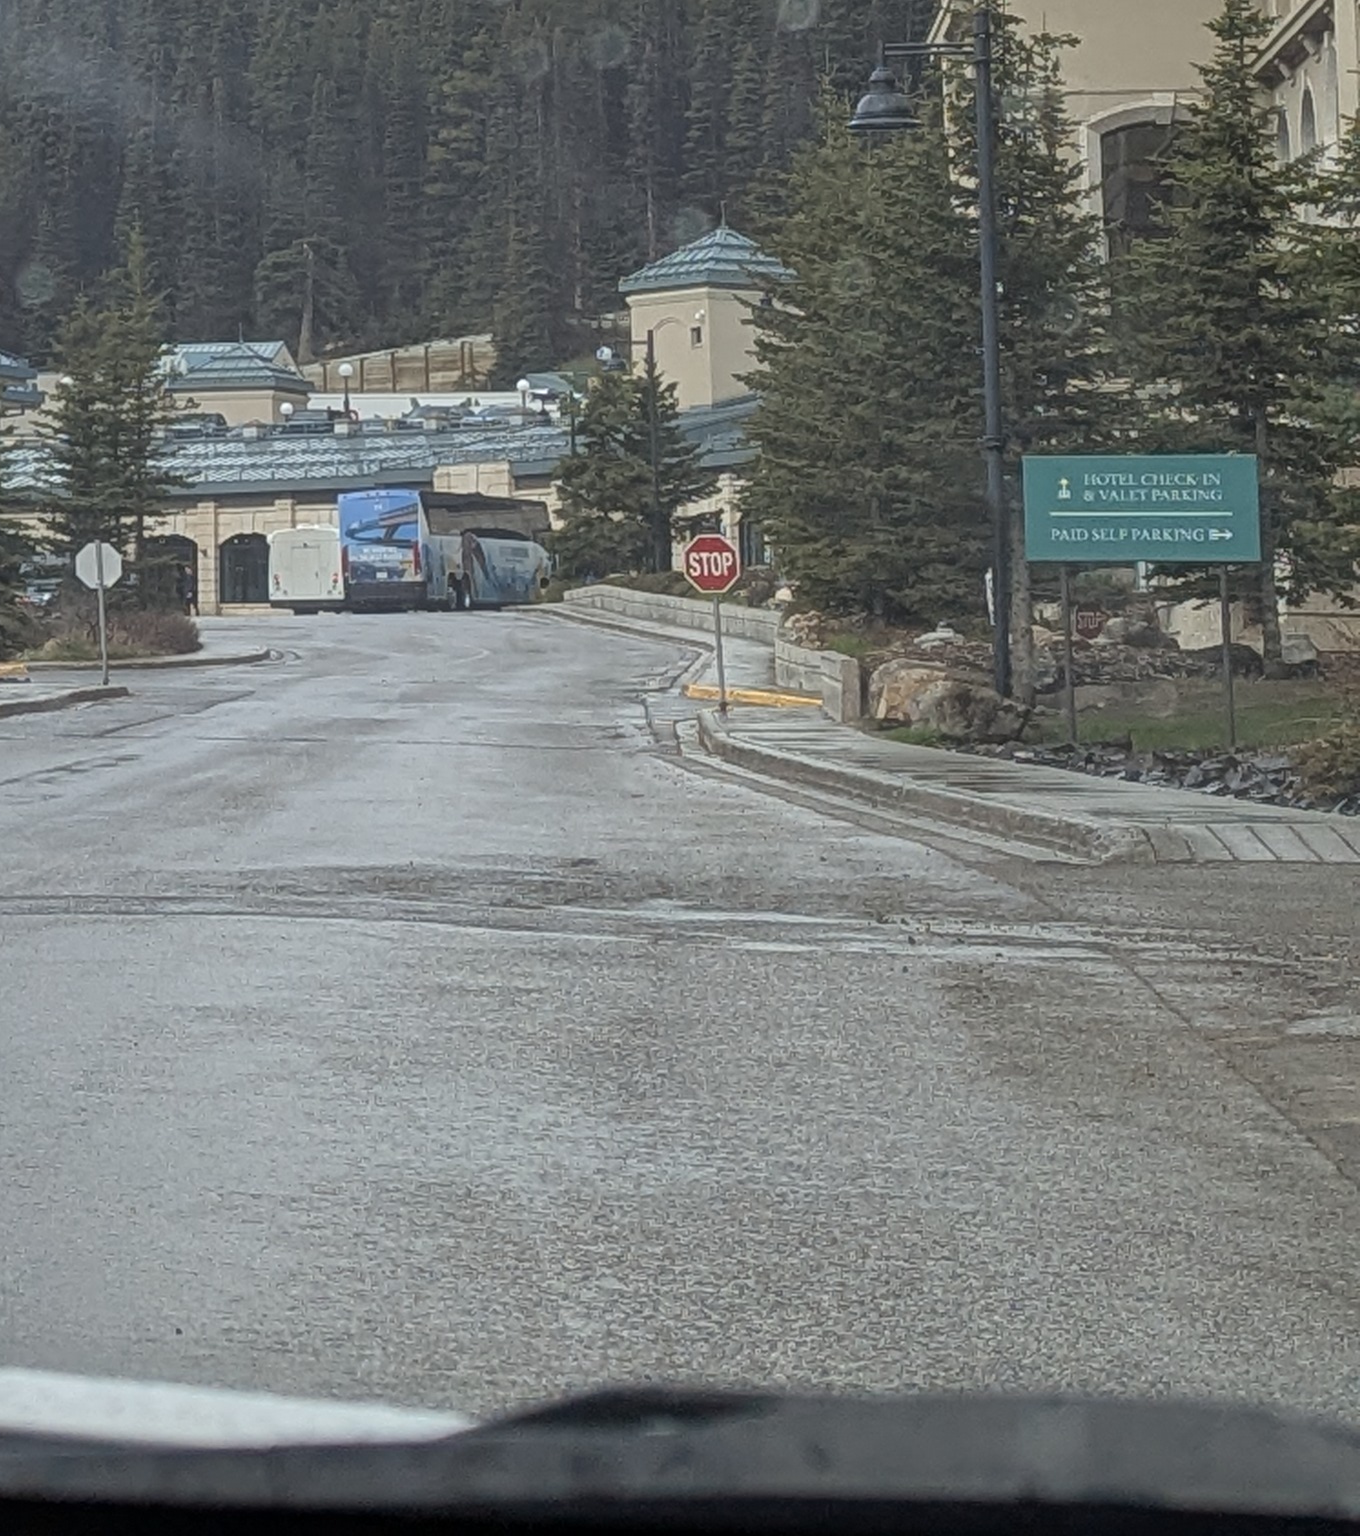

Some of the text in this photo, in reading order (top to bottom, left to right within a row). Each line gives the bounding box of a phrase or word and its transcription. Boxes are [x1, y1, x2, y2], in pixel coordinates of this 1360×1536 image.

[1084, 473, 1139, 486] HOTEL
[1083, 488, 1223, 502] & VALET PARKING
[1050, 527, 1205, 542] PAID SELF PARKING
[688, 551, 733, 577] STOP
